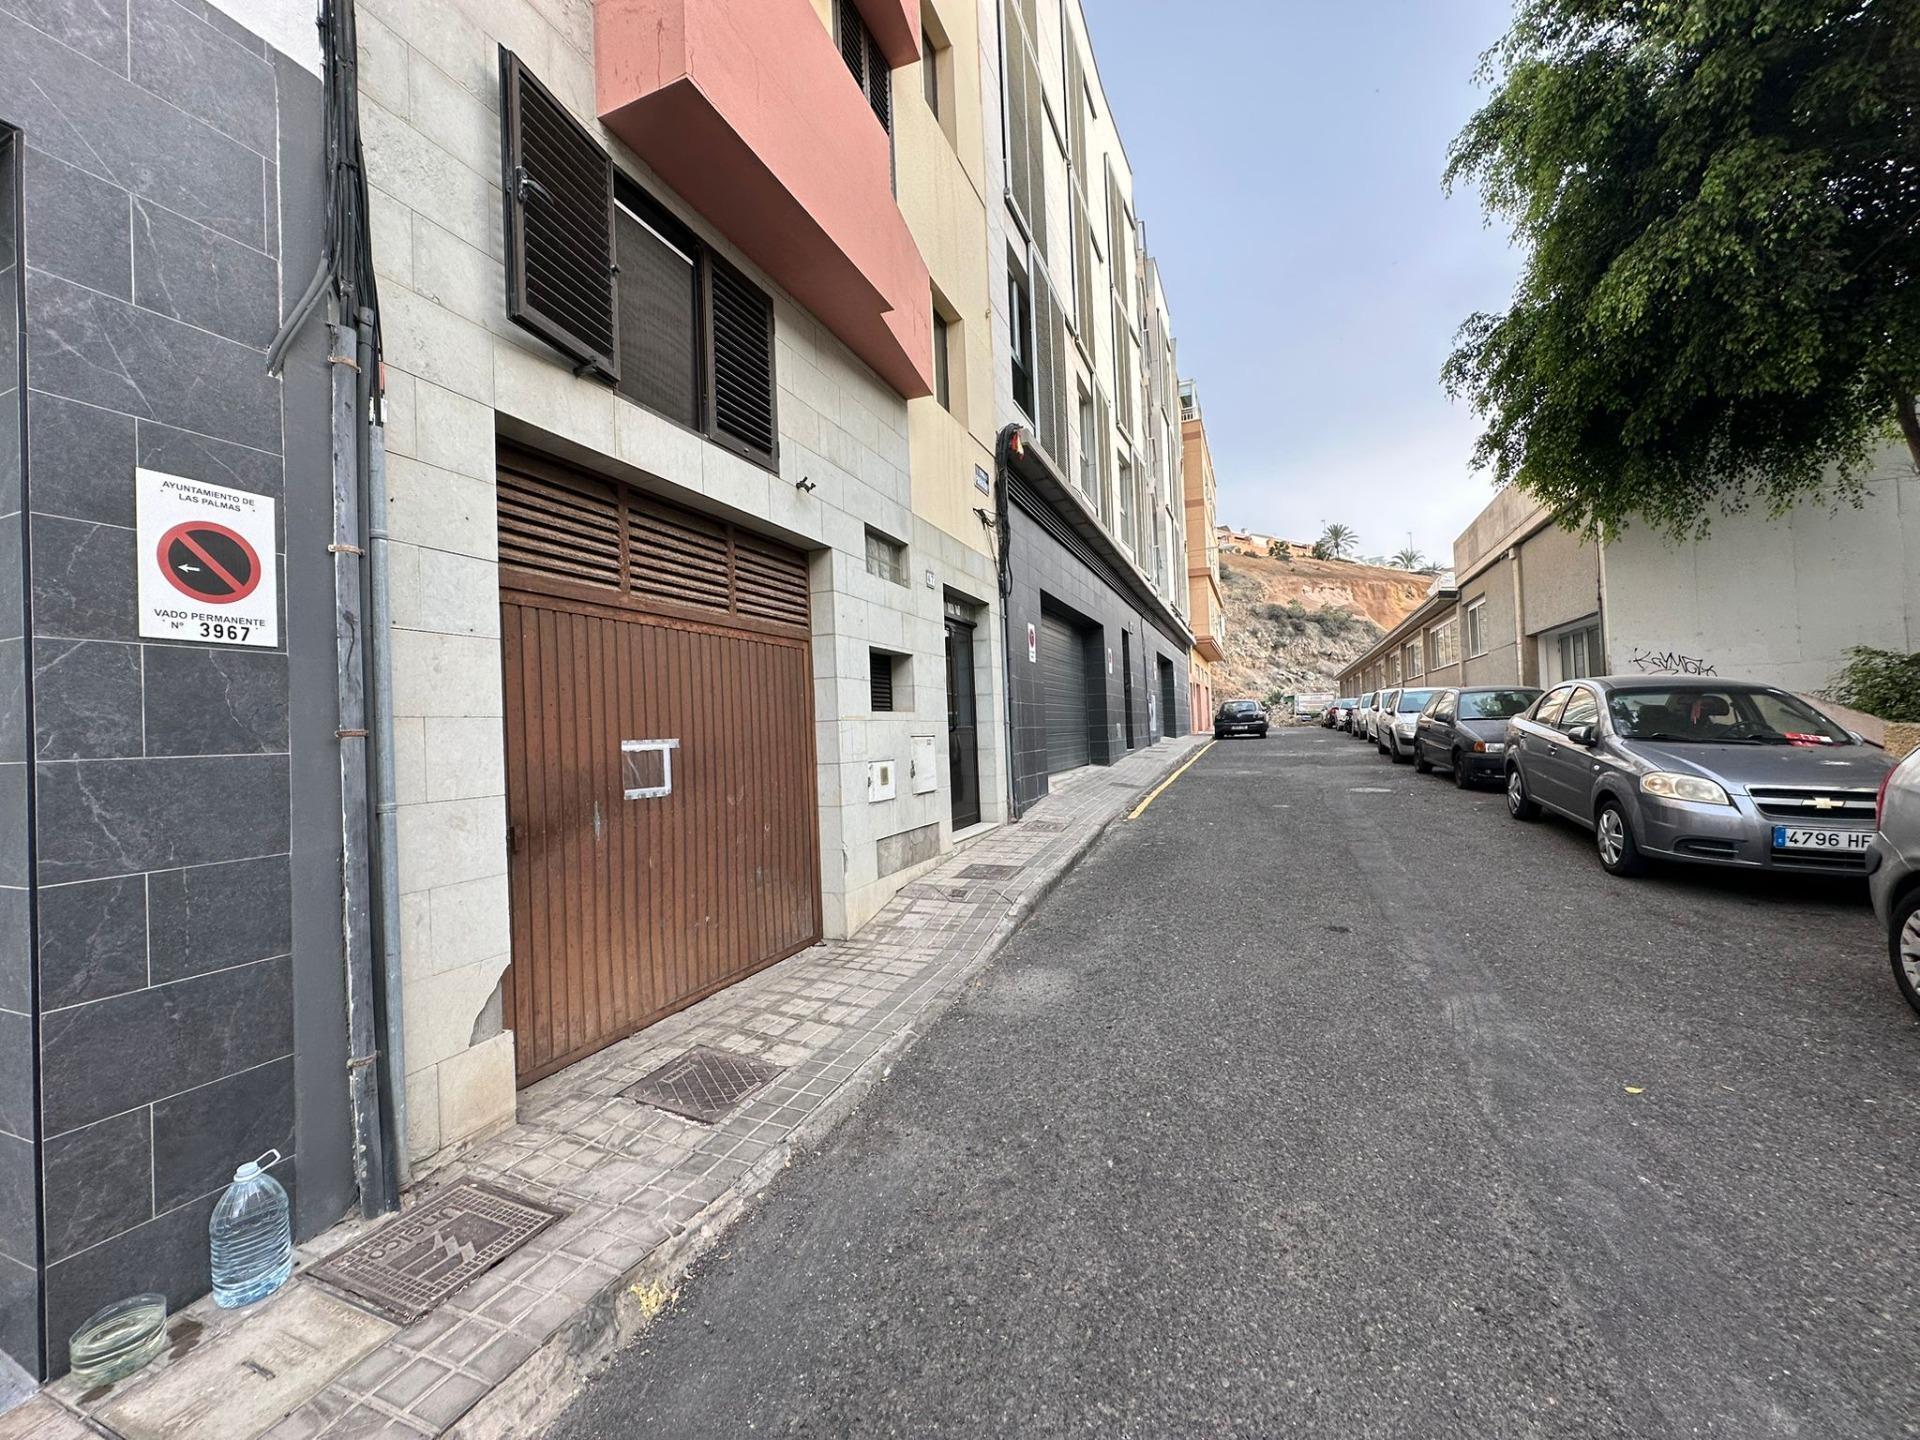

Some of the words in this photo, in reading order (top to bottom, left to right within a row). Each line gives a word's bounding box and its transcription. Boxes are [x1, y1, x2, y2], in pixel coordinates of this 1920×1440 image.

[162, 481, 240, 503] AYUNTAMIENTO
[242, 497, 256, 507] DE
[178, 493, 199, 504] LAS
[201, 498, 241, 512] PALMAS
[154, 608, 188, 620] VADO
[191, 612, 266, 627] PERMANENTE
[200, 622, 250, 642] 3967
[1787, 831, 1840, 847] 4796
[1847, 834, 1873, 848] HF
